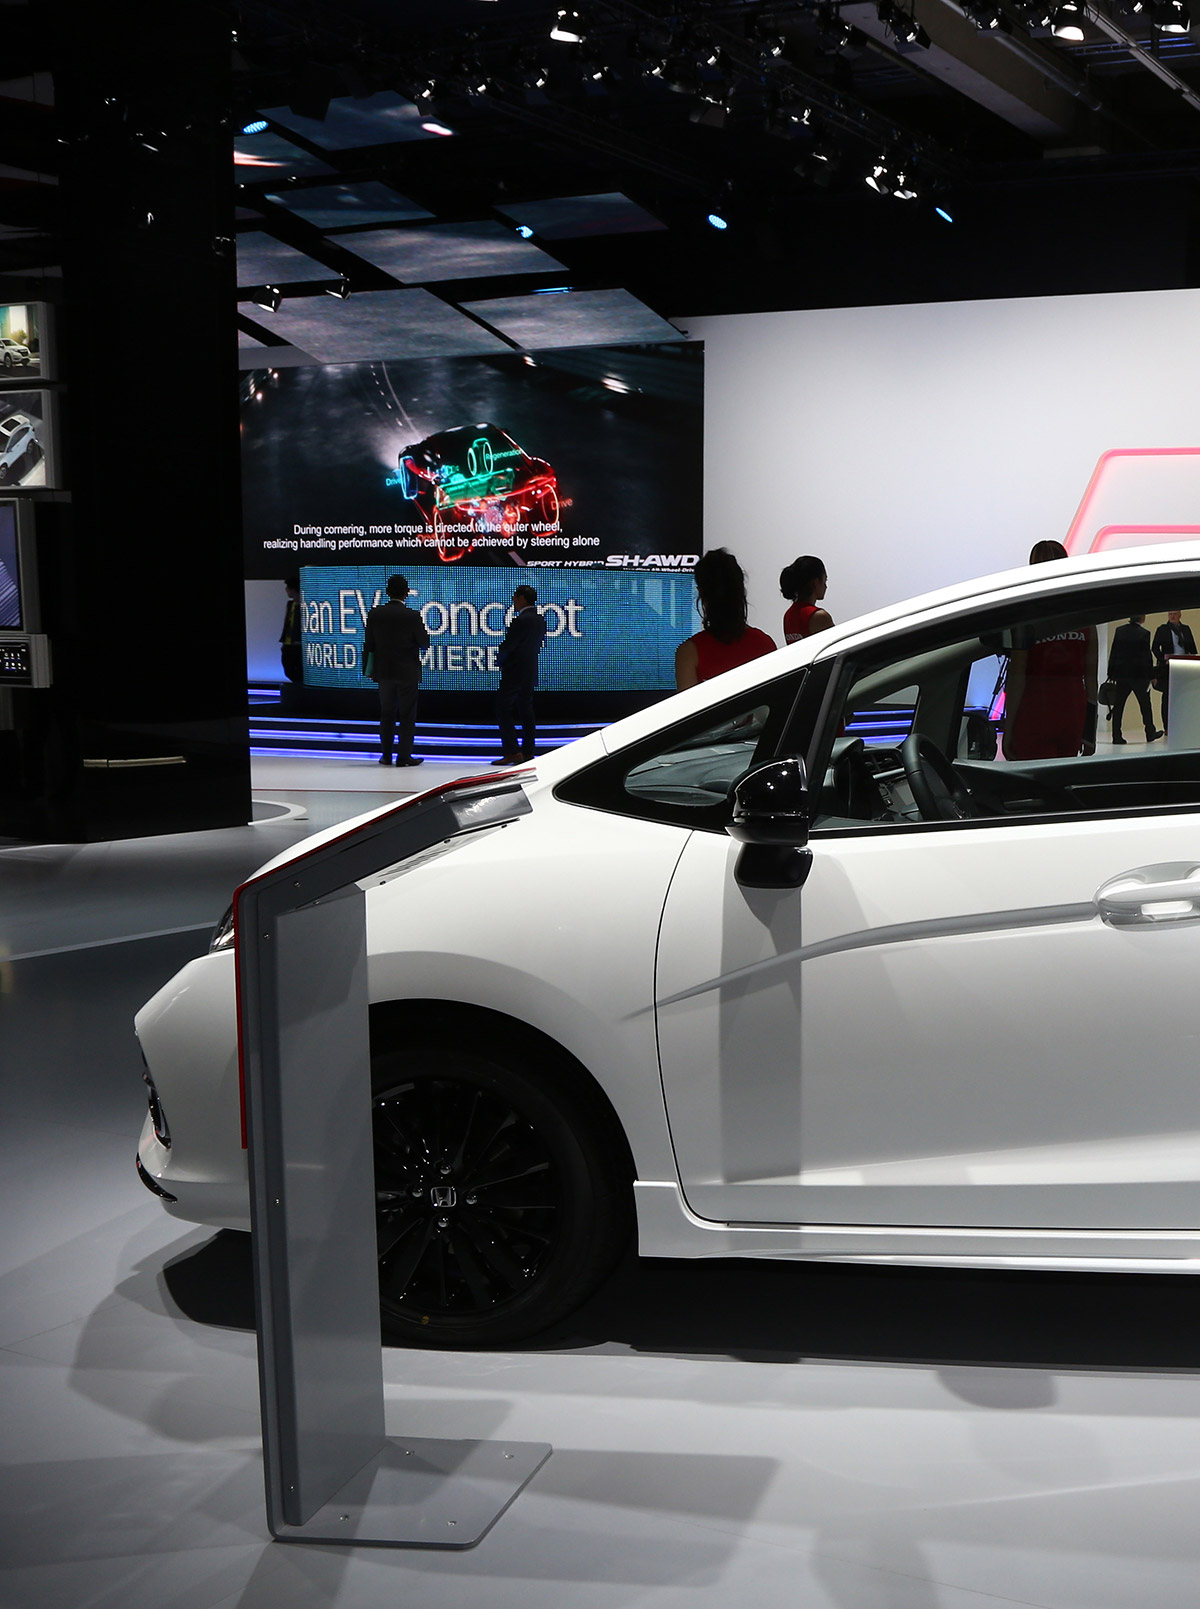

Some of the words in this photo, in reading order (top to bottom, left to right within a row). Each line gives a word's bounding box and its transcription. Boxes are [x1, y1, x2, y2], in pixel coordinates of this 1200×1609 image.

[386, 476, 402, 486] Driv
[294, 524, 322, 536] During
[324, 523, 367, 536] cornering,
[369, 526, 392, 534] more
[394, 523, 423, 535] torque
[426, 523, 433, 533] is
[435, 522, 473, 533] directed
[475, 523, 484, 533] to
[485, 522, 501, 532] the
[503, 522, 529, 532] outer
[531, 521, 563, 533] wheel,
[263, 538, 298, 551] realizing
[300, 538, 336, 550] handling
[338, 538, 393, 550] performance
[395, 537, 422, 547] which
[424, 537, 456, 547] cannot
[457, 537, 470, 547] be
[472, 536, 514, 547] achieved
[516, 536, 528, 549] by
[531, 536, 569, 549] steering
[573, 535, 600, 546] alone
[605, 555, 700, 566] SH-AWD
[408, 589, 584, 647] oncpt
[306, 643, 356, 668] WORLD
[419, 646, 500, 671] MIERE
